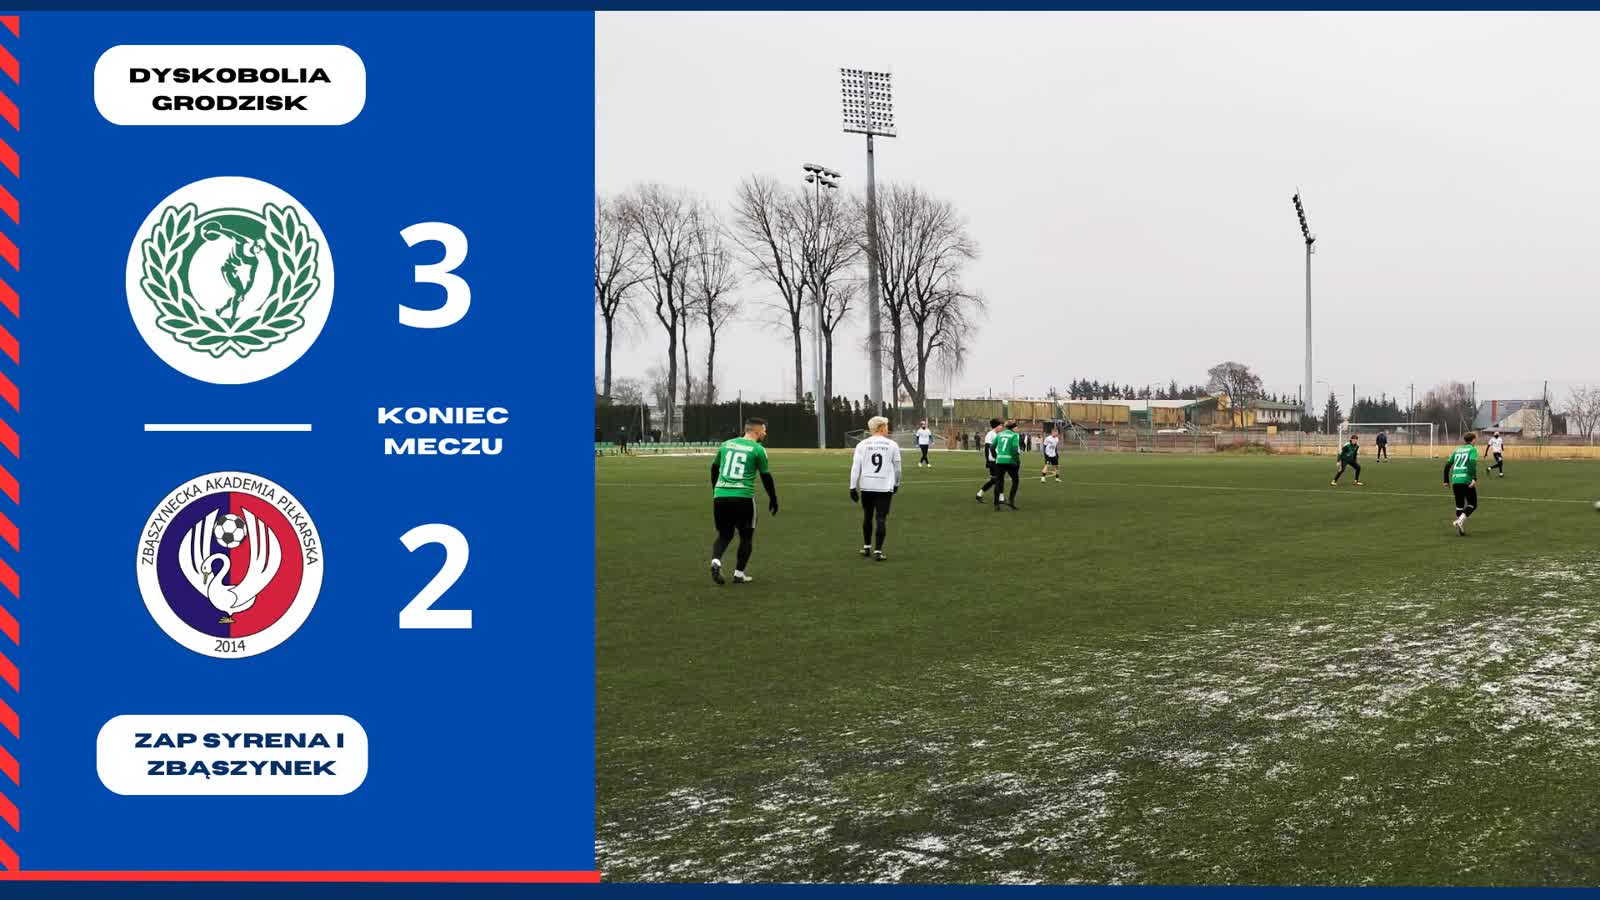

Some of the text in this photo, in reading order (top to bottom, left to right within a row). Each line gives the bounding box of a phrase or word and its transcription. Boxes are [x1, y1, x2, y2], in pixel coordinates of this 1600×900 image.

[1001, 437, 1008, 451] 7
[723, 451, 747, 480] 16
[871, 452, 883, 473] 9
[1453, 453, 1469, 470] 22
